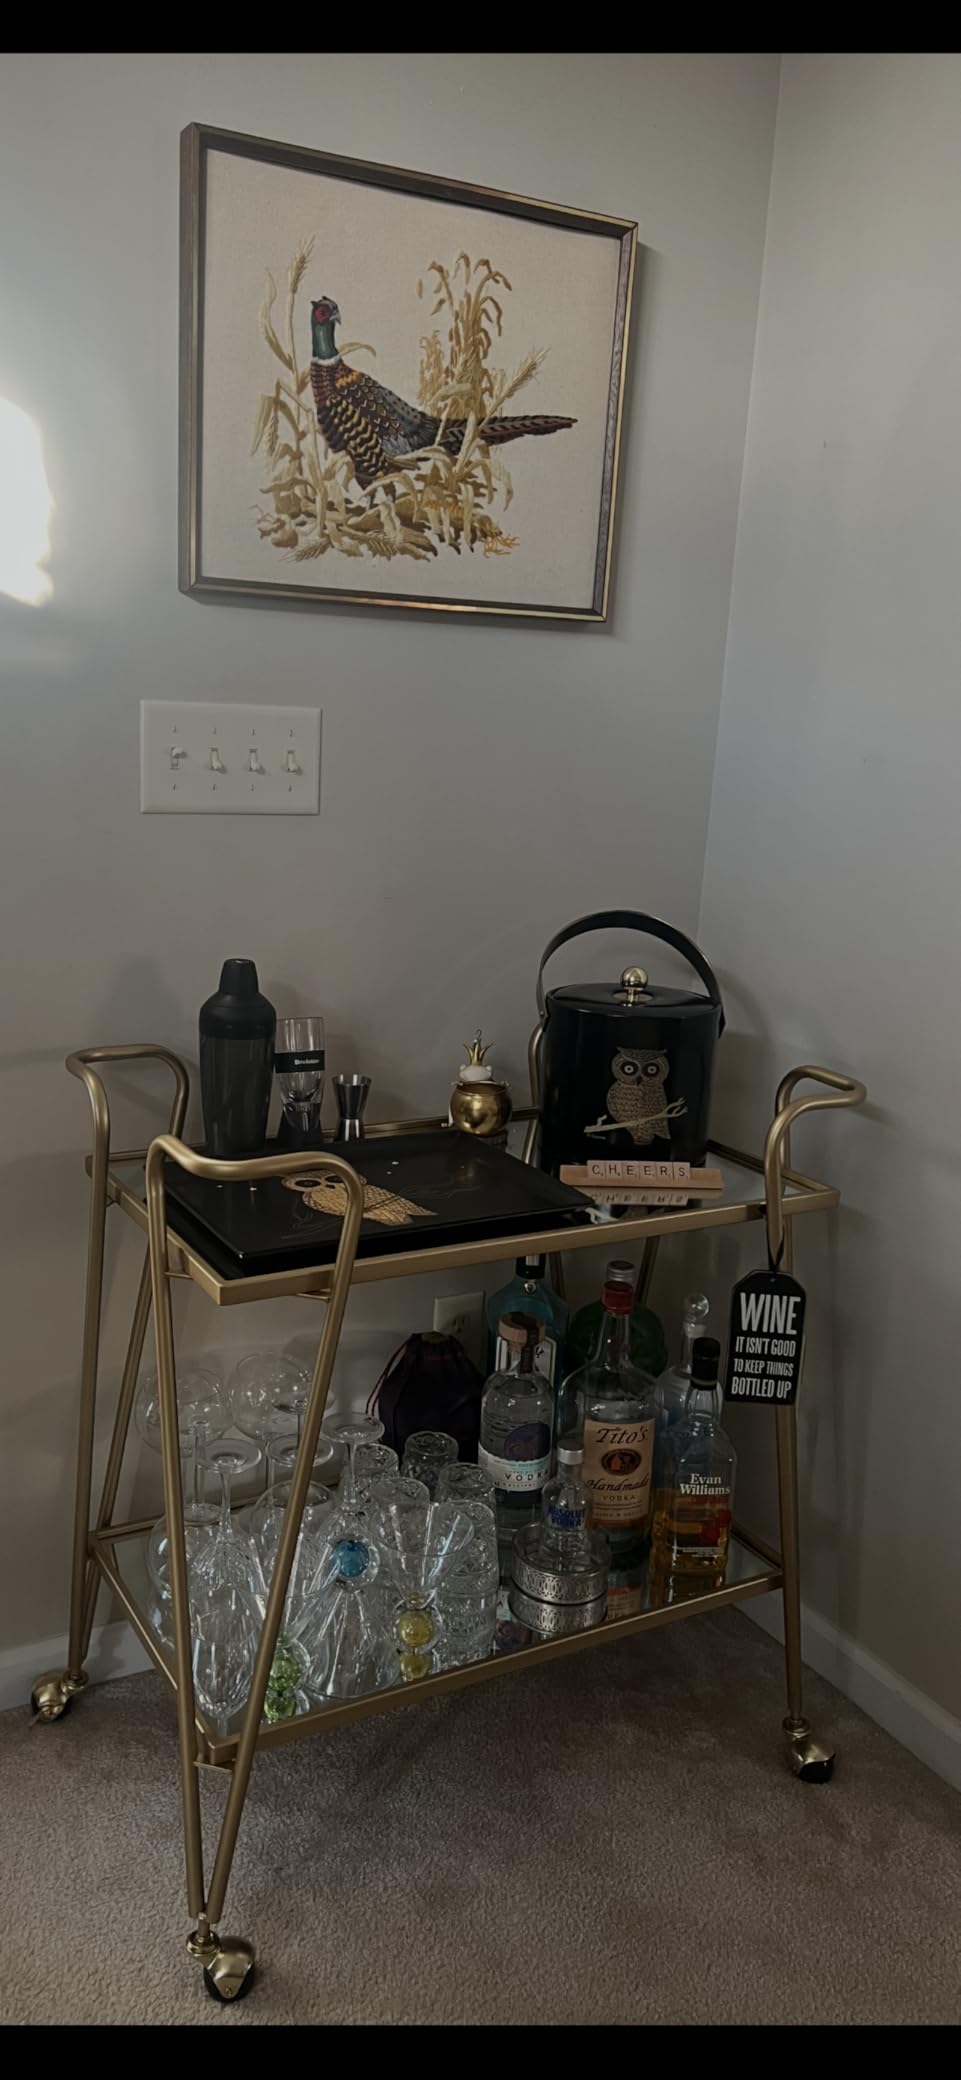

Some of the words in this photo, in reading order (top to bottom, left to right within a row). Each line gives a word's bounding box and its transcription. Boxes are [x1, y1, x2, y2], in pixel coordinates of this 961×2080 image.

[591, 1164, 686, 1177] CHEERS
[740, 1291, 801, 1335] WINE
[735, 1336, 746, 1353] IT
[745, 1337, 771, 1355] ISN'T
[770, 1339, 797, 1357] GOOD
[733, 1358, 744, 1373] TO
[744, 1358, 766, 1375] KEEP
[766, 1361, 794, 1377] THINGS
[731, 1376, 775, 1398] BOTTLED
[776, 1380, 792, 1400] UP
[596, 1425, 648, 1444] Tito's
[505, 1468, 549, 1482] VODKA
[690, 1472, 722, 1485] Evan
[680, 1483, 731, 1495] Williams
[601, 1494, 636, 1502] VODKA
